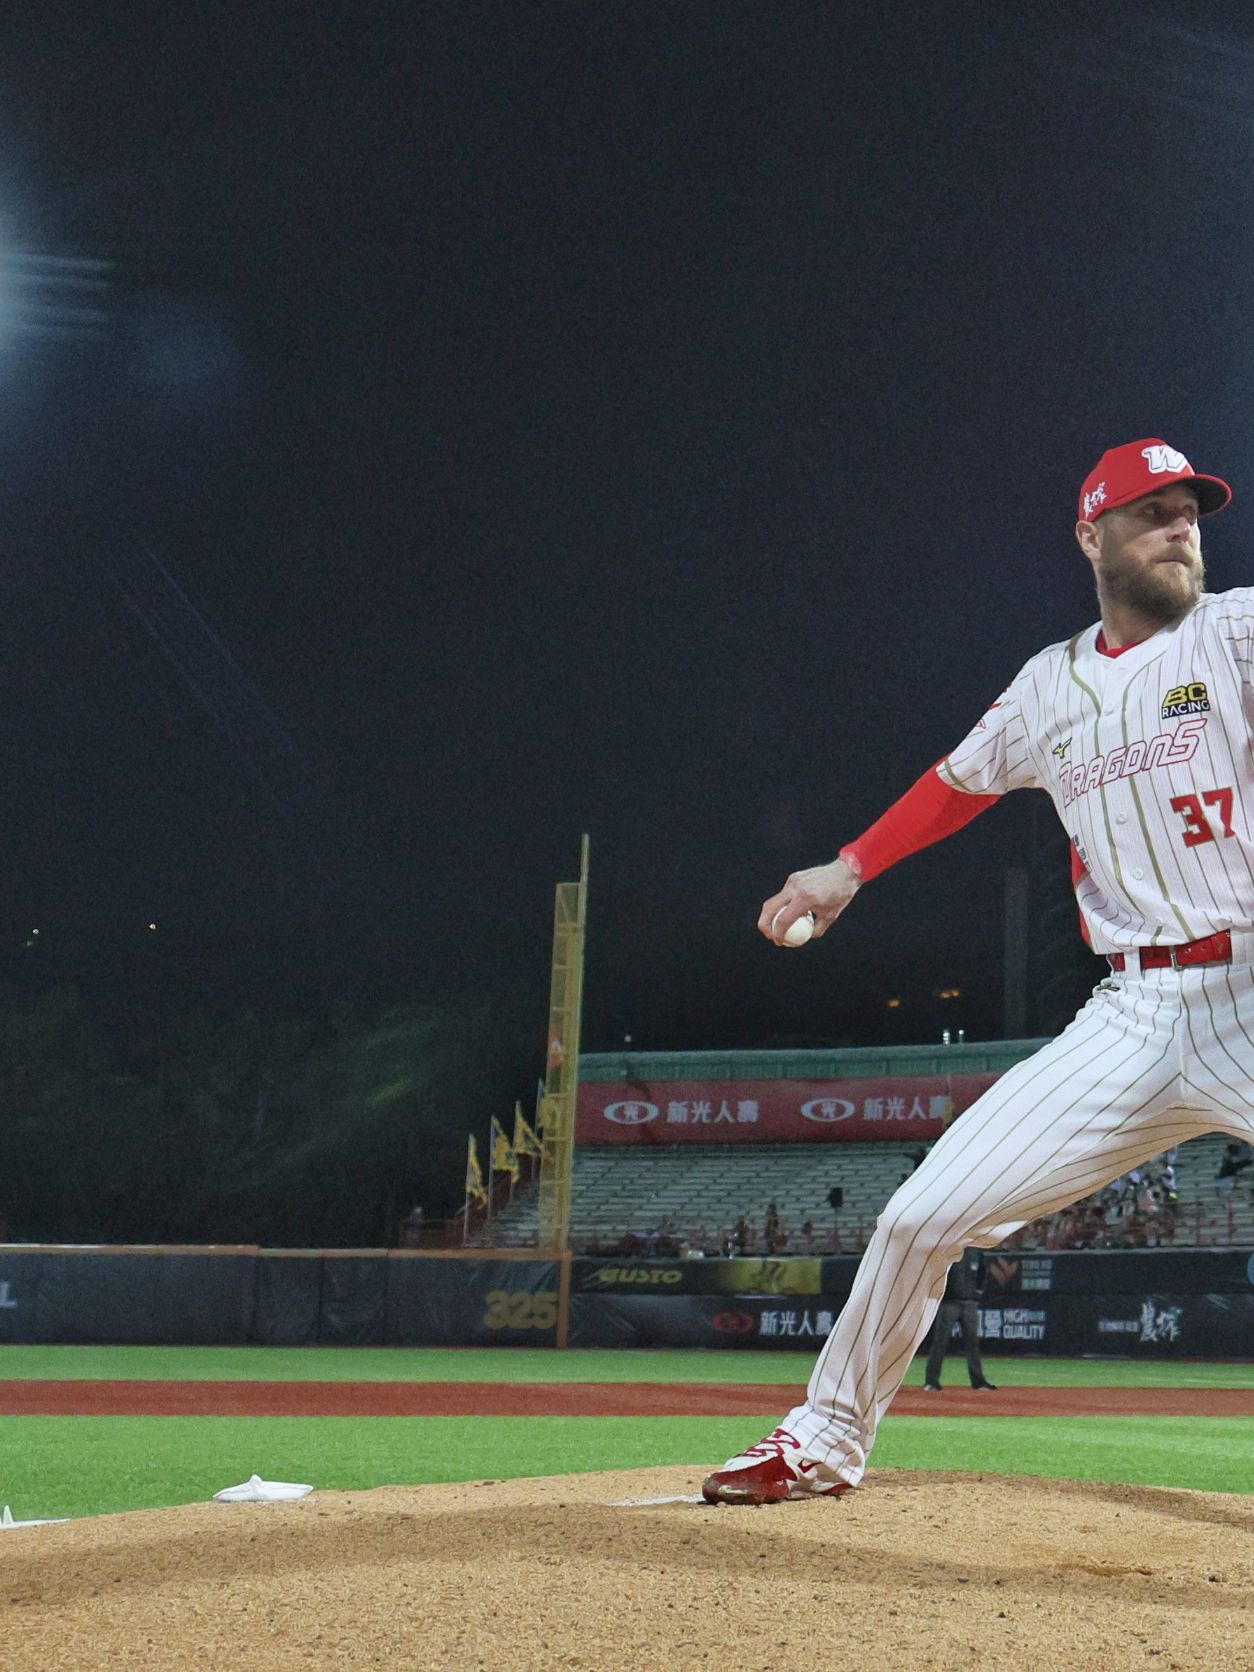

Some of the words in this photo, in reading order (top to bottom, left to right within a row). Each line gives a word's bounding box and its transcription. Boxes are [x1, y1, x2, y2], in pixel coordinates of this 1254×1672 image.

[1163, 683, 1208, 707] BC
[1162, 701, 1210, 718] RACING
[1169, 787, 1236, 848] 37
[666, 1099, 759, 1124] 新光人壽
[484, 1291, 558, 1330] 325
[759, 1310, 833, 1336] 新光人壽
